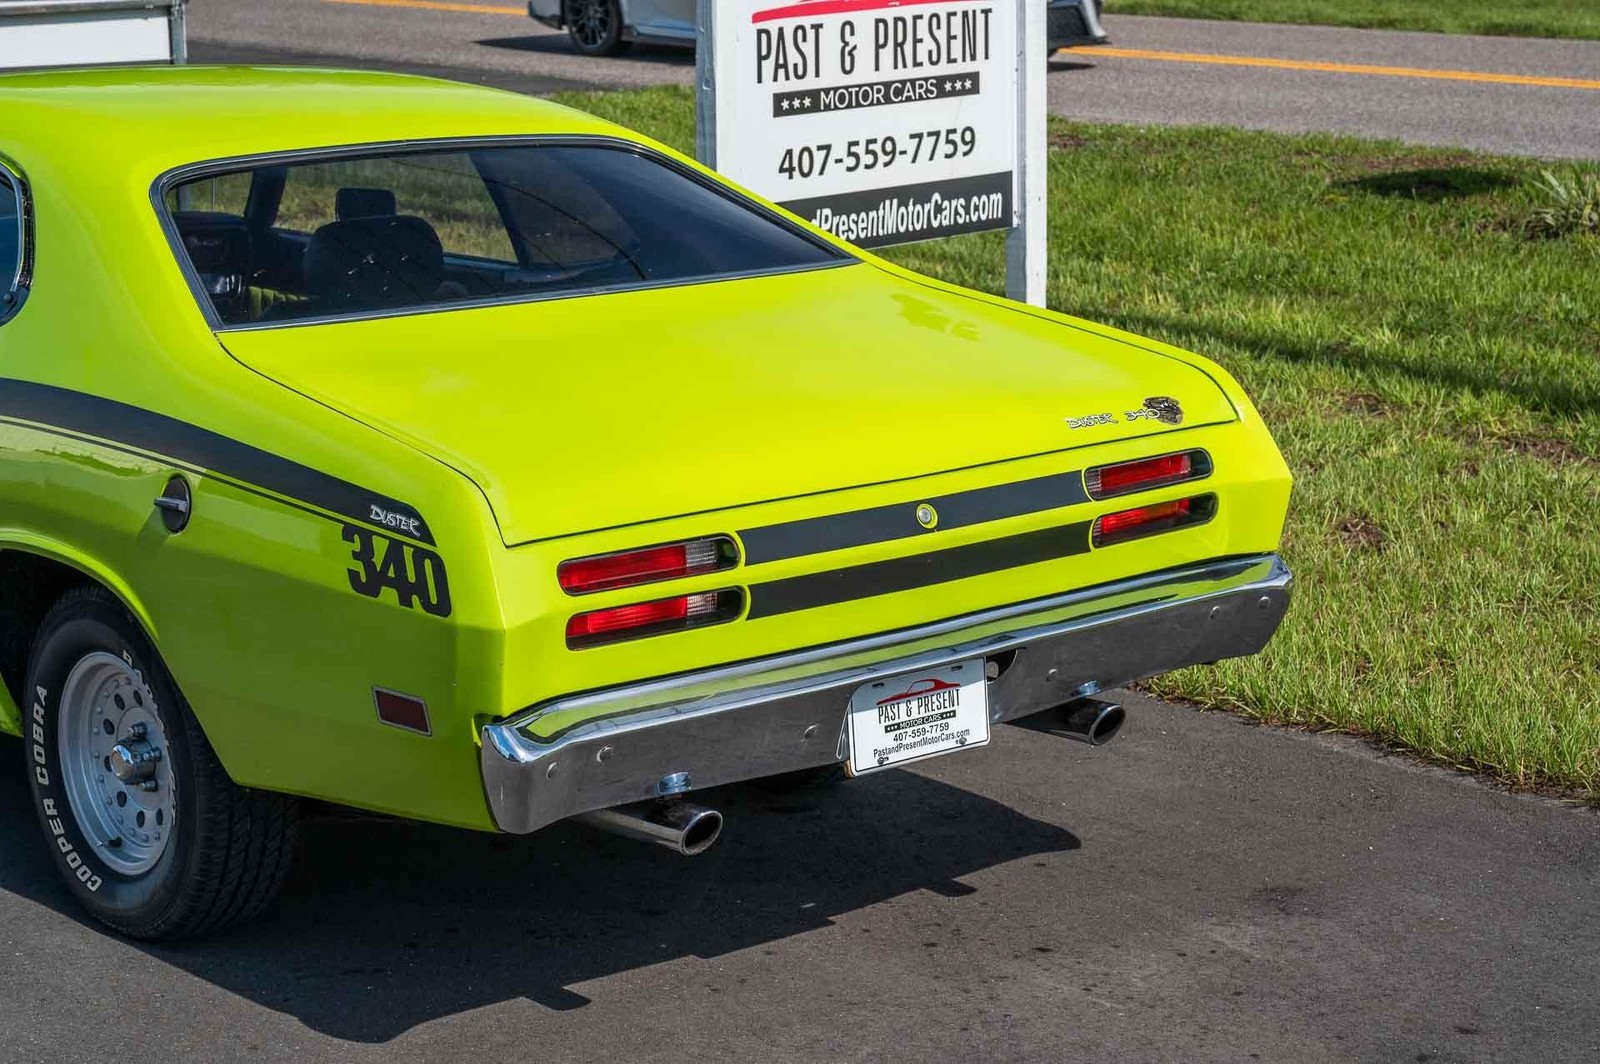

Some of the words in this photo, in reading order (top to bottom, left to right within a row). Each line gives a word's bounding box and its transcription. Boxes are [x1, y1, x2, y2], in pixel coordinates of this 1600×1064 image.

[756, 23, 824, 84] PAST
[840, 20, 857, 75] &
[874, 8, 993, 72] PRESENT
[820, 84, 885, 110] MOTOR
[890, 79, 938, 101] CARS
[778, 126, 976, 180] 407-559-7759
[1066, 413, 1119, 428] DUSTER
[369, 504, 421, 538] DUSTER
[341, 522, 452, 618] 340
[878, 702, 901, 724] PAST
[906, 699, 913, 718] &
[917, 688, 961, 715] PRESENT
[900, 719, 923, 730] MOTOR
[924, 713, 941, 724] CARS
[32, 685, 48, 786] COBRA
[873, 727, 971, 758] PastandPresentMotorCars.com
[893, 721, 950, 743] 407-559-7759
[43, 798, 102, 892] COOPER
